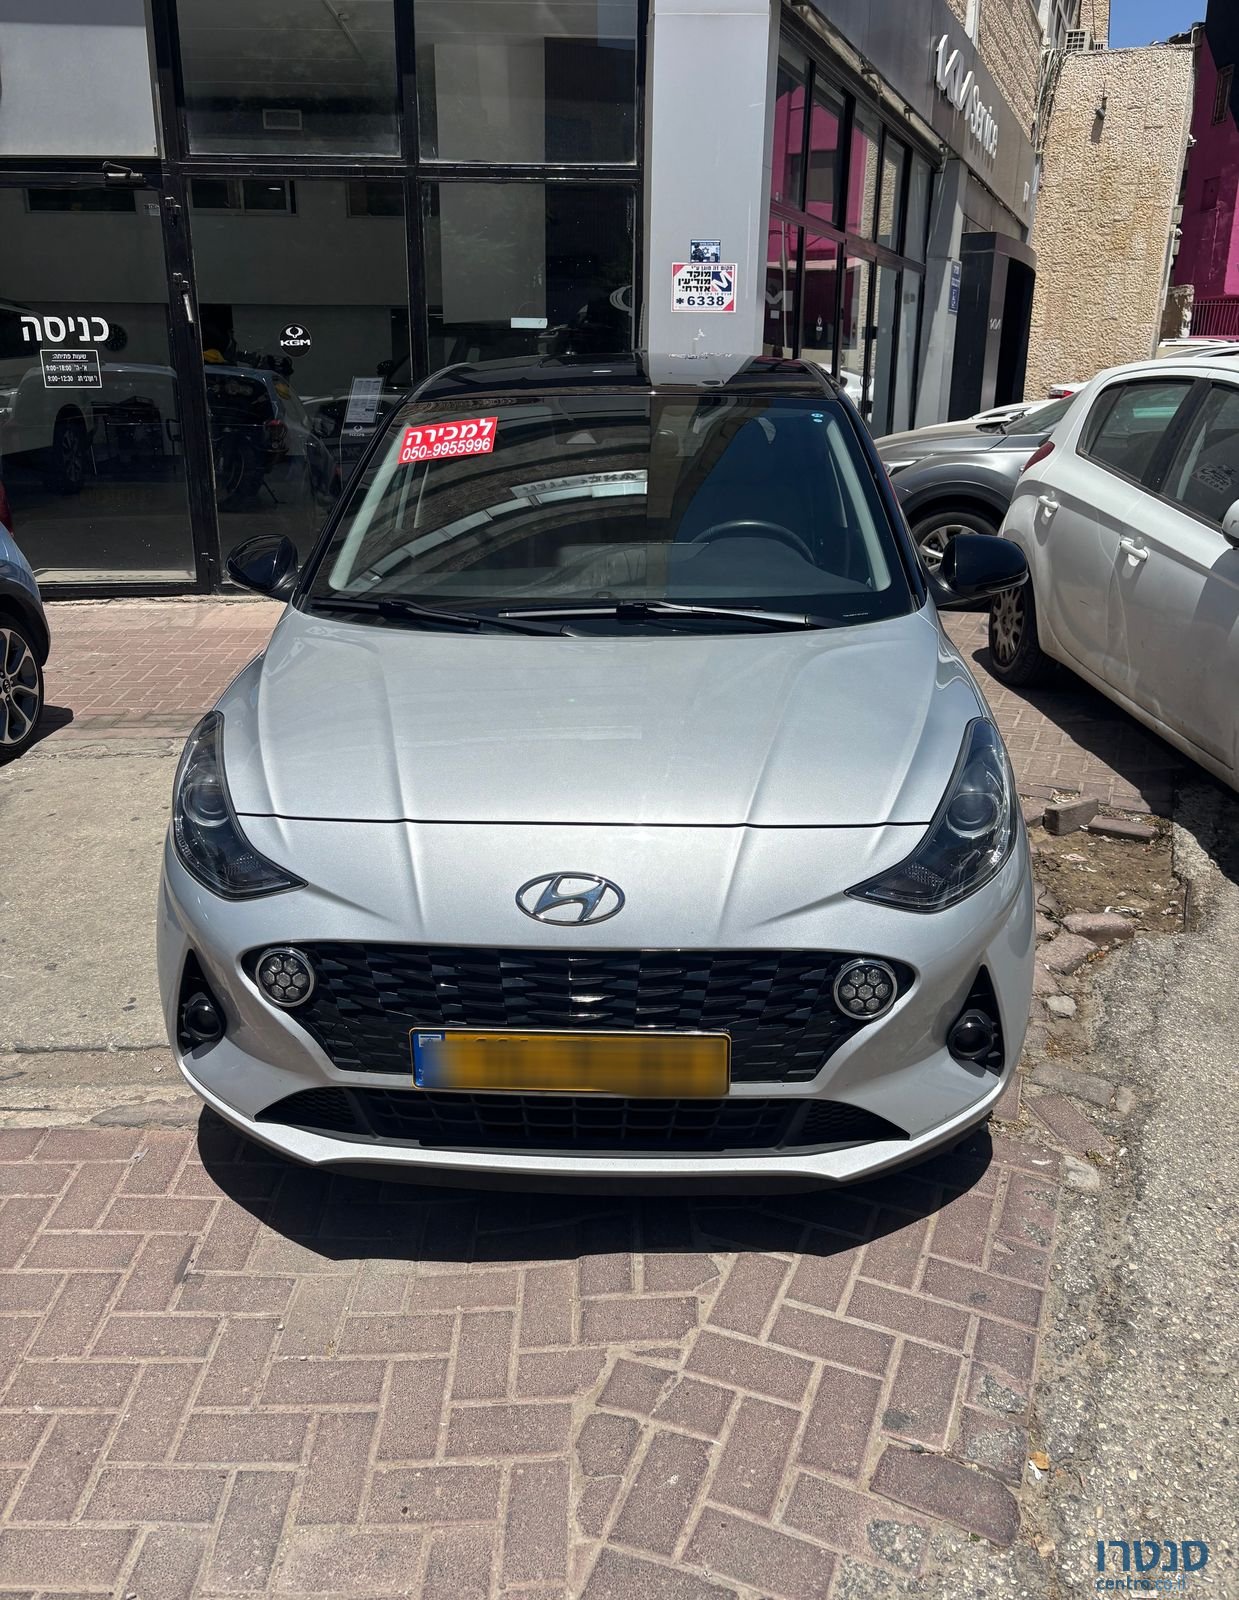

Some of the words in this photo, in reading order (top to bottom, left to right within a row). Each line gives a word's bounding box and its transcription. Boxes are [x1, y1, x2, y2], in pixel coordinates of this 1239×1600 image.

[970, 85, 998, 159] Service
[678, 278, 711, 286] מודיעין
[20, 316, 109, 342] כניסה
[405, 419, 493, 446] למכירה
[402, 437, 491, 461] 050-9955996
